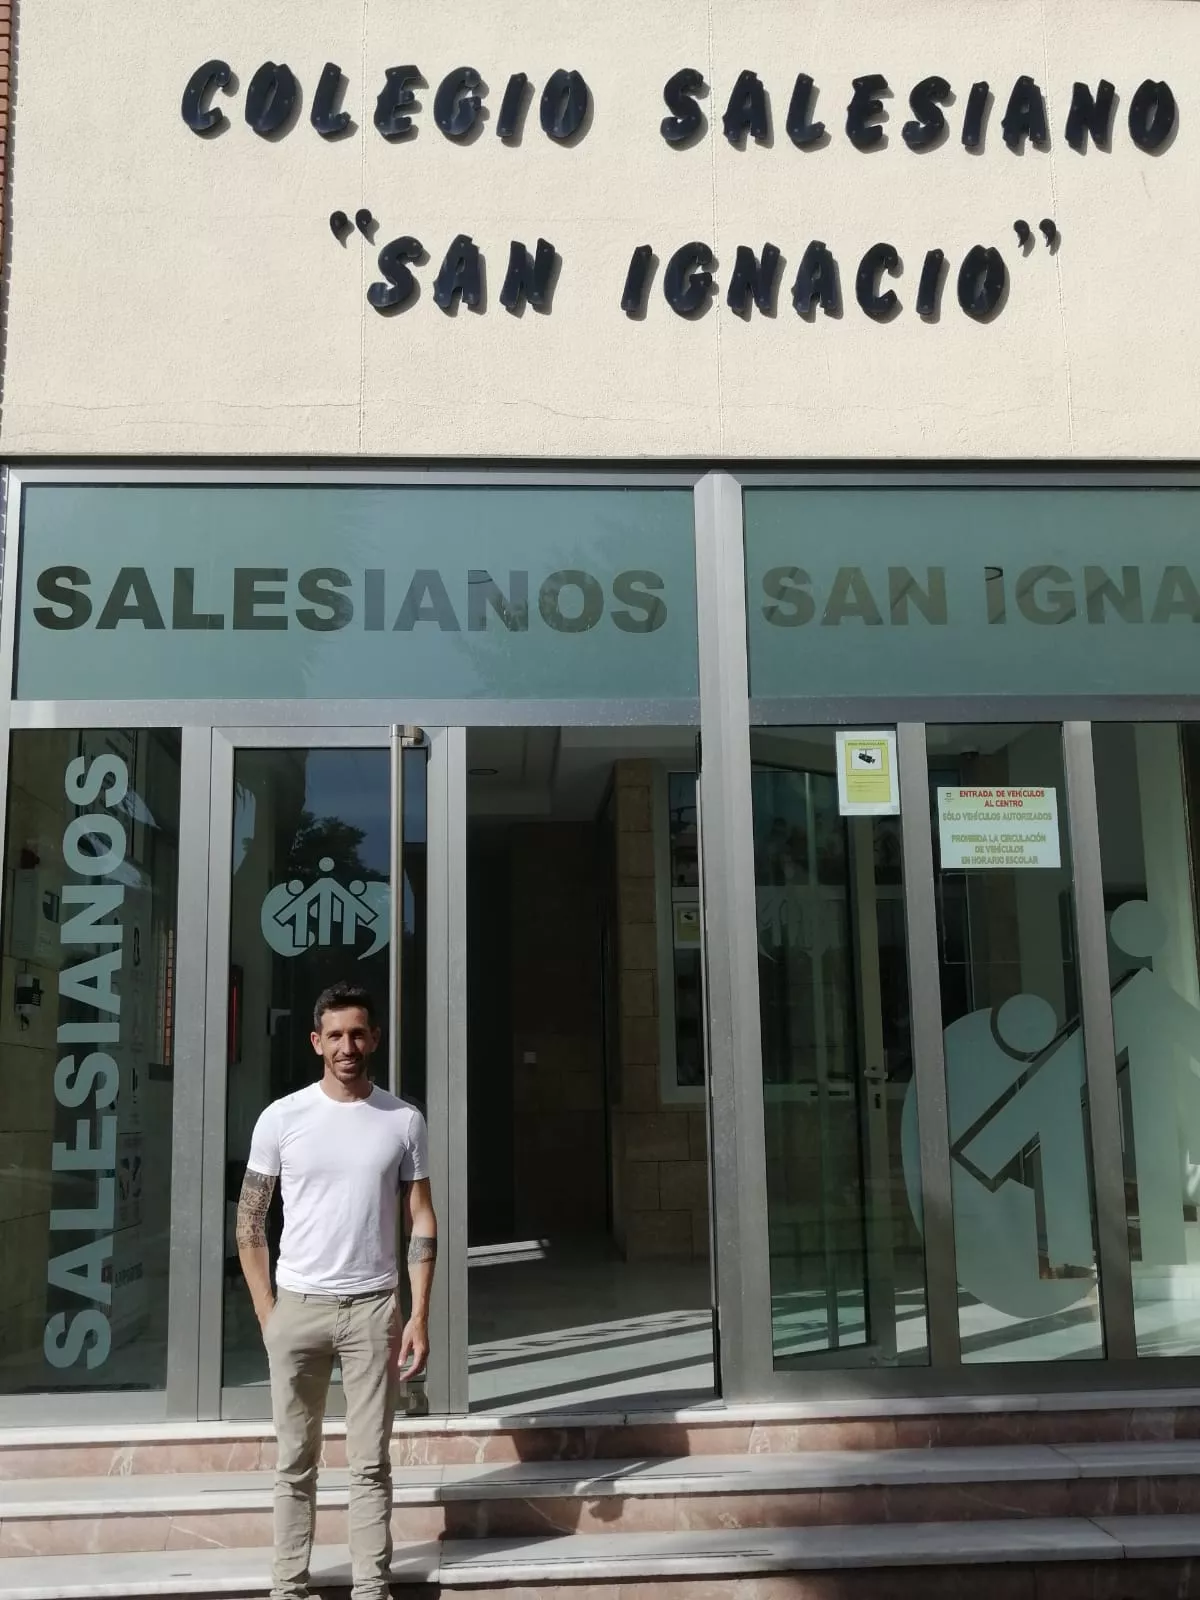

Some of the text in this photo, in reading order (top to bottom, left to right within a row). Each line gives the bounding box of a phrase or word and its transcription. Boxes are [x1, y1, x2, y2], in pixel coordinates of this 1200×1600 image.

[181, 58, 1178, 153] COLEGIO SALESIANO
[32, 563, 1200, 634] SALESIANOS SAN IGNA
[959, 788, 1045, 798] ENTRADA DE VEHÍCULOS
[942, 811, 1053, 820] SÓLO VEHÍCULOS AUTORIZADOS
[951, 832, 1046, 843] PROHIBIDA LA CIRCULACIÓN
[974, 843, 1024, 853] DE VEHÍCULOS
[961, 856, 1039, 865] EN HORARIO ESCOLAR
[43, 752, 130, 1370] SALESIANOS
